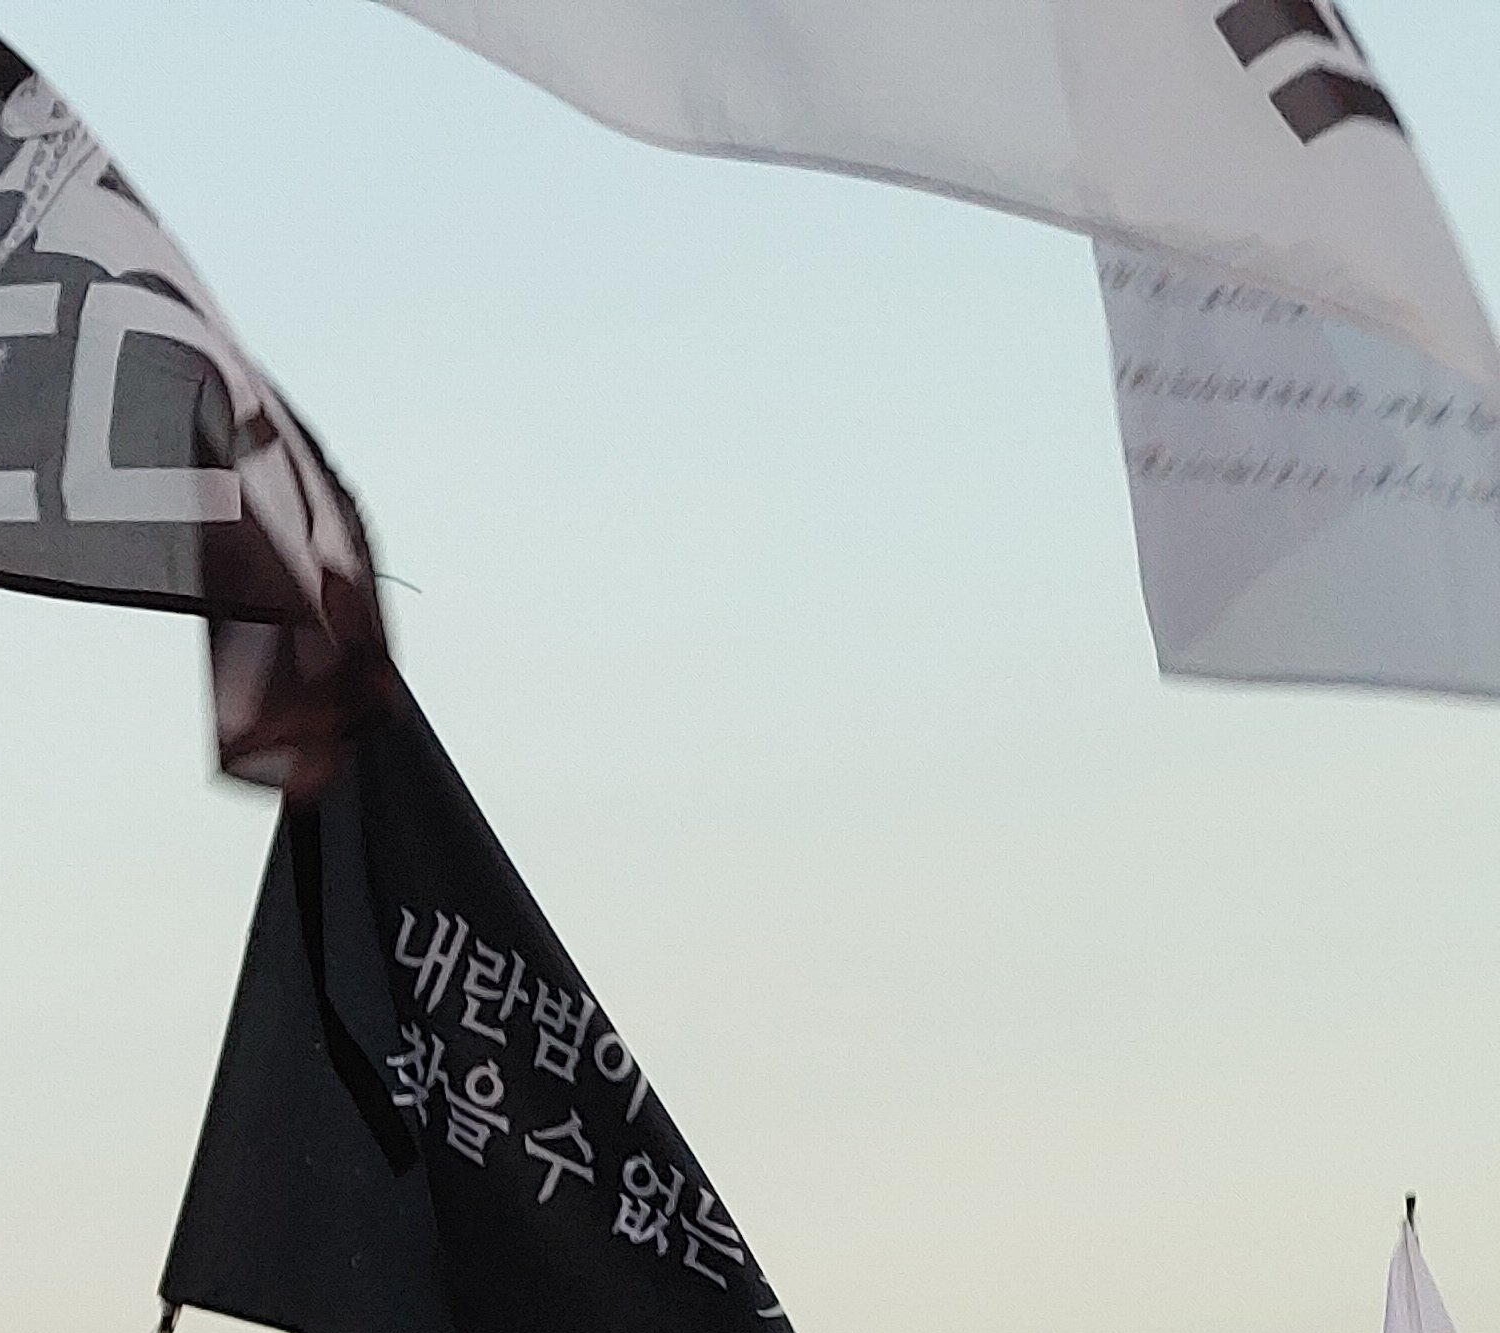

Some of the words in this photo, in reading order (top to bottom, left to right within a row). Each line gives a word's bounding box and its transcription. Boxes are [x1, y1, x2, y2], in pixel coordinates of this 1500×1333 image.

[393, 905, 649, 1123] 내란범이
[386, 1021, 510, 1167] 찾을
[523, 1106, 596, 1203] 수
[611, 1152, 747, 1290] 없는
